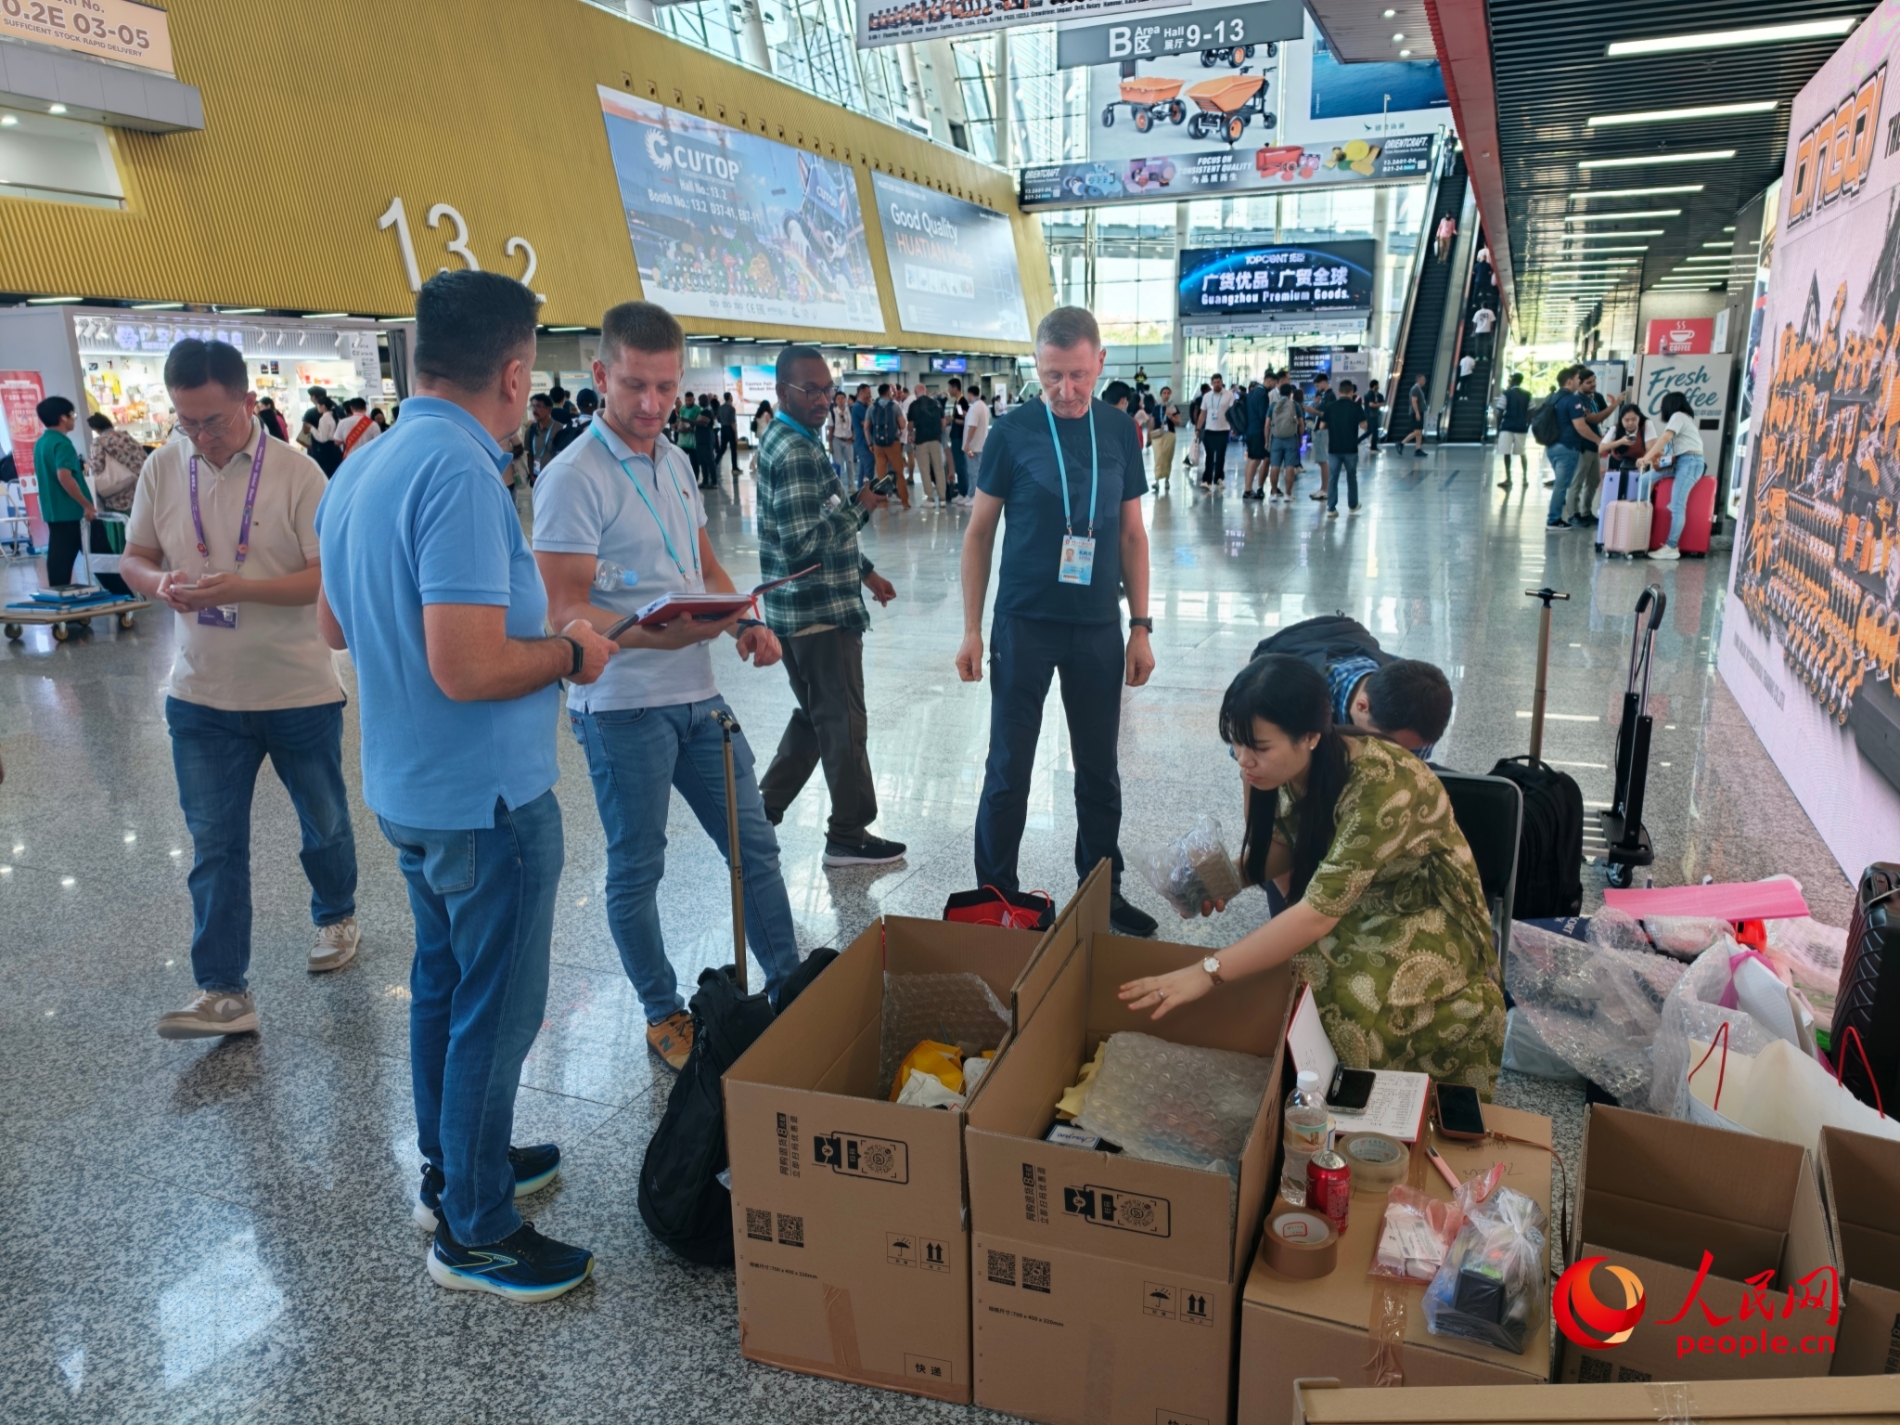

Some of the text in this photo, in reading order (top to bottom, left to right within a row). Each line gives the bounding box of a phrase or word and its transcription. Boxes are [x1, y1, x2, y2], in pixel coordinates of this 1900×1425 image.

[3, 18, 143, 58] SUFFICIENT STOCK RAPID DELIVERY
[73, 12, 150, 49] 03-05
[1109, 25, 1160, 58] B Area
[1163, 18, 1244, 47] Hall 9-13
[1134, 35, 1184, 55] 区 展厅
[674, 146, 739, 181] CUTOP
[1179, 162, 1253, 175] CONSISTENT QUALITY
[1197, 155, 1233, 165] FOCUS ON
[648, 188, 673, 205] Booth
[679, 179, 693, 192] Hall
[890, 202, 958, 246] Good Quality
[1202, 266, 1349, 292] 广货优品 广贸全球
[1201, 288, 1349, 306] Guangzhou Premium Goods.
[1669, 343, 1691, 351] COFFEE
[1647, 365, 1711, 396] Fresh
[1648, 386, 1719, 415] Cffee
[915, 1363, 942, 1377] 快递
